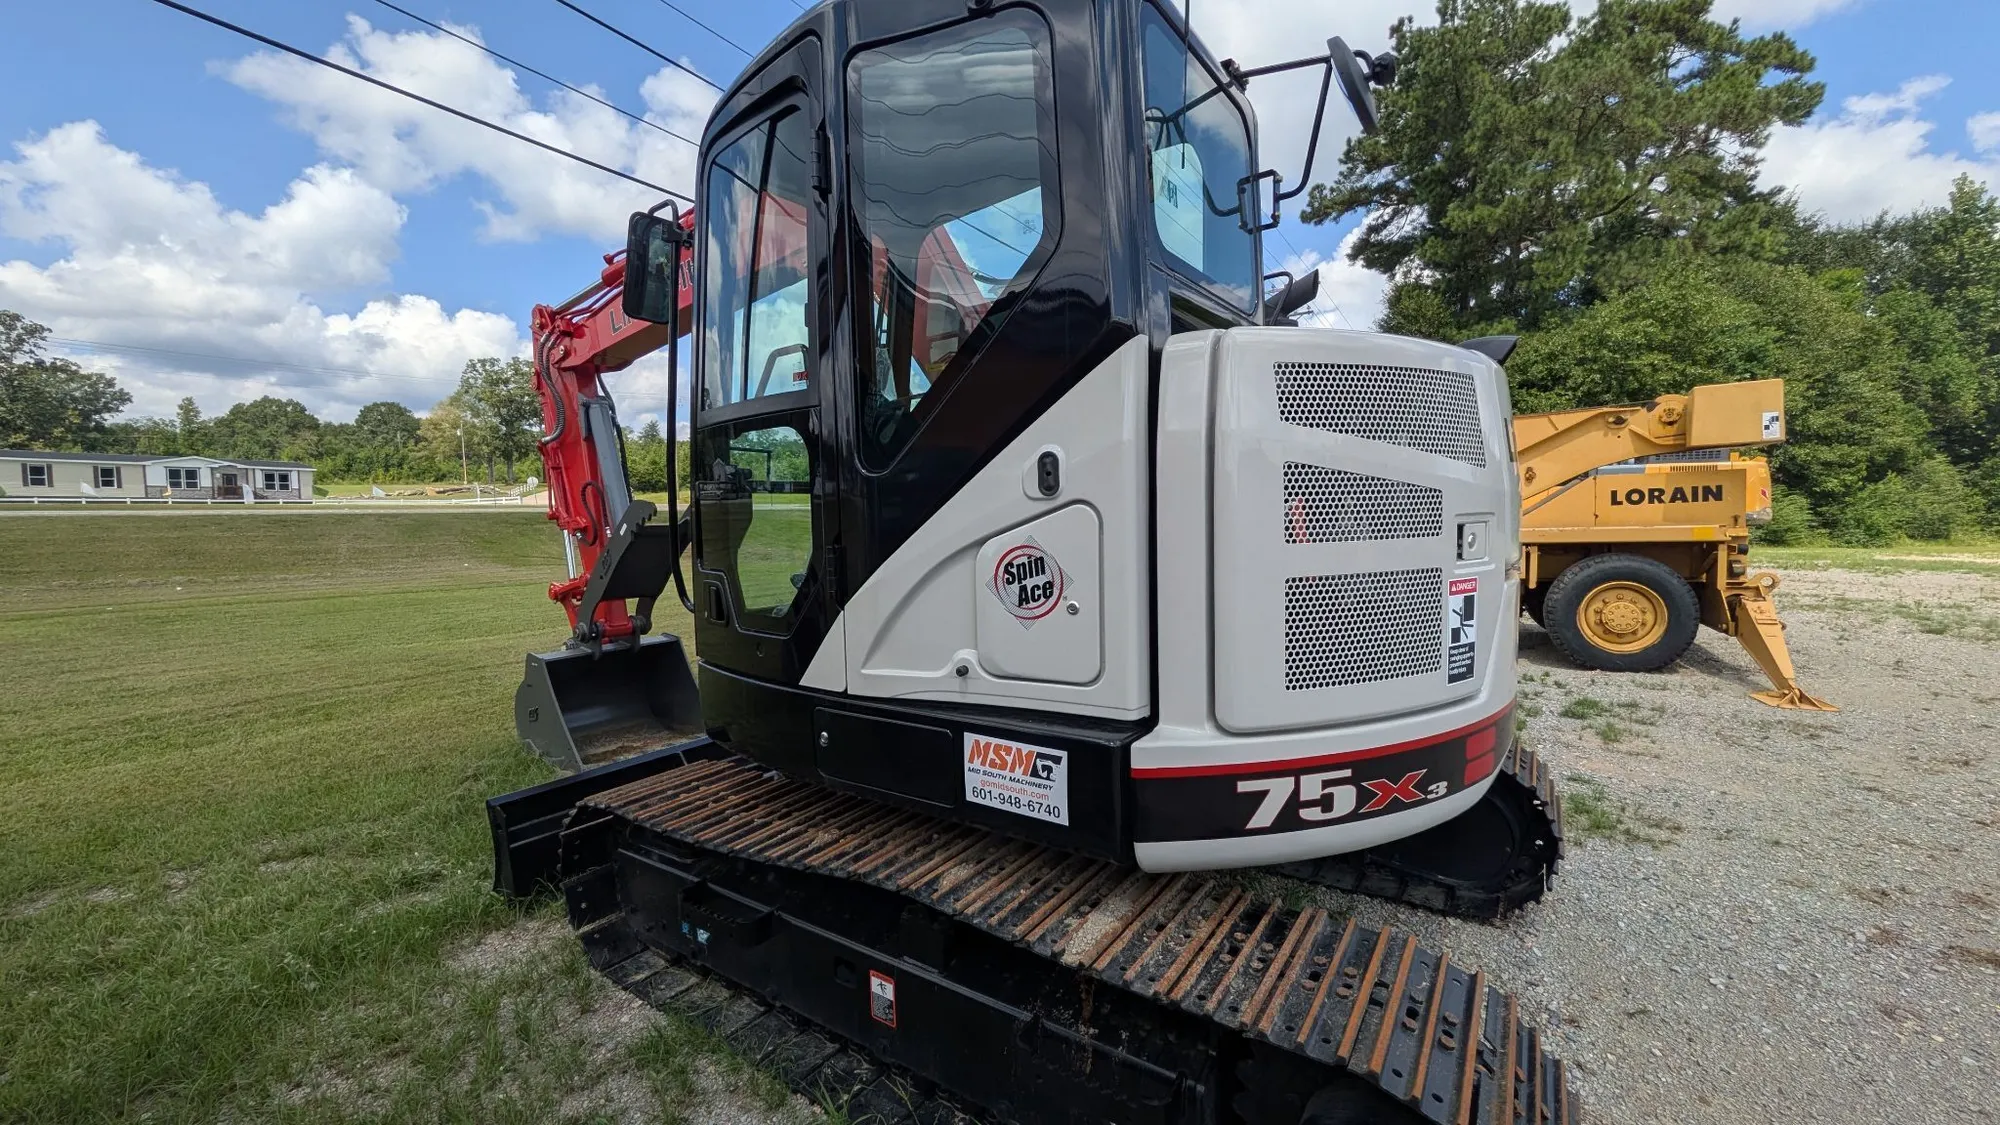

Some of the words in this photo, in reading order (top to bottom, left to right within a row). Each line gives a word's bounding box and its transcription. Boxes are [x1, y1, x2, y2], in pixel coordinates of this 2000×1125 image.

[1611, 485, 1723, 506] LORAIN
[1004, 555, 1046, 586] Spin
[1018, 580, 1055, 607] Ace
[1456, 581, 1476, 591] DANGER
[968, 766, 981, 775] MID
[982, 769, 1008, 781] SOUTH
[1008, 776, 1054, 792] MACHINERY
[980, 779, 1050, 802] gomidsouth.com
[972, 786, 1061, 819] 601-948-6740
